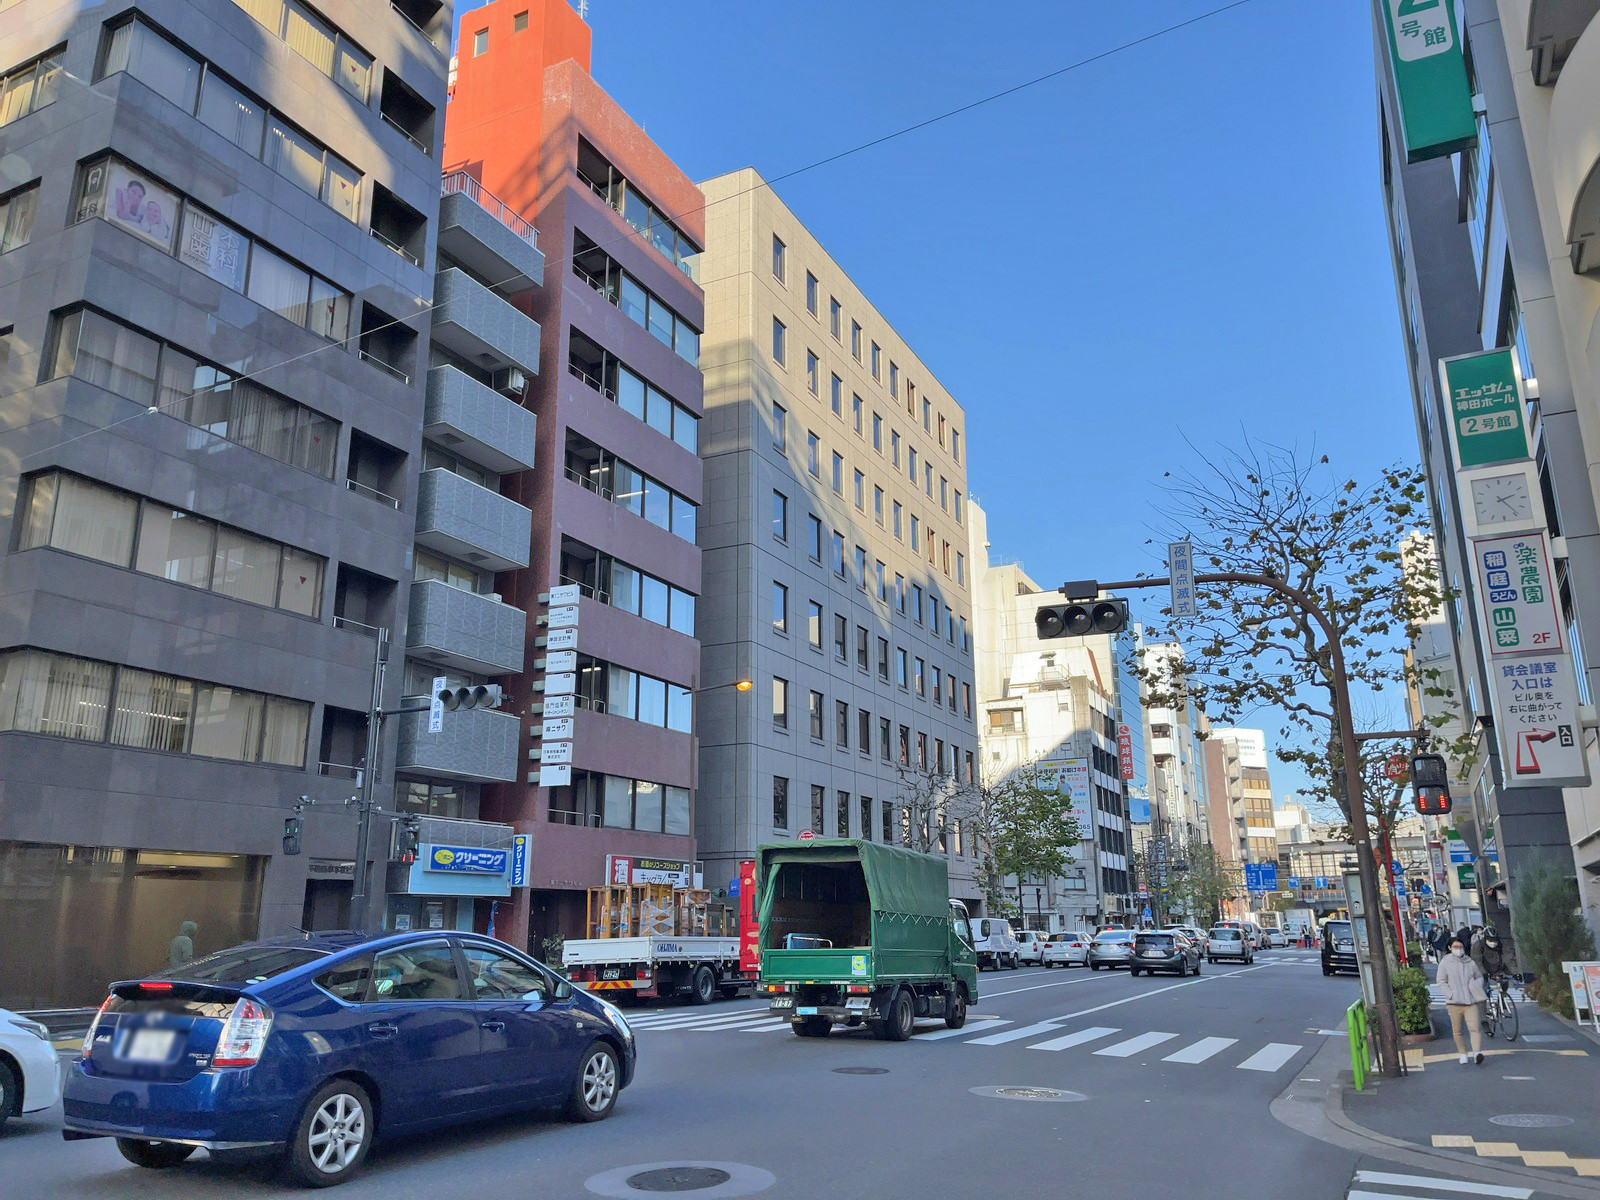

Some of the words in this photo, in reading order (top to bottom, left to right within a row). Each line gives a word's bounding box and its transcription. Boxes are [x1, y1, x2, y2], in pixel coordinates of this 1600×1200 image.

[1400, 19, 1447, 48] 号館
[1455, 382, 1513, 400] エッサム
[1456, 394, 1515, 411] 神田ホール
[1466, 415, 1512, 433] 2号館
[1174, 545, 1191, 614] 夜間点滅式
[1532, 632, 1550, 644] 2F
[1502, 662, 1558, 678] 貸会議室
[1511, 678, 1553, 691] 入口は
[1514, 691, 1554, 702] ビル奥を
[1508, 702, 1562, 714] 右に曲がって
[1519, 714, 1558, 723] ください
[1560, 726, 1573, 745] 入口
[455, 851, 504, 866] クリーニング
[514, 845, 523, 884] クリーニング
[614, 859, 629, 883] 酒
